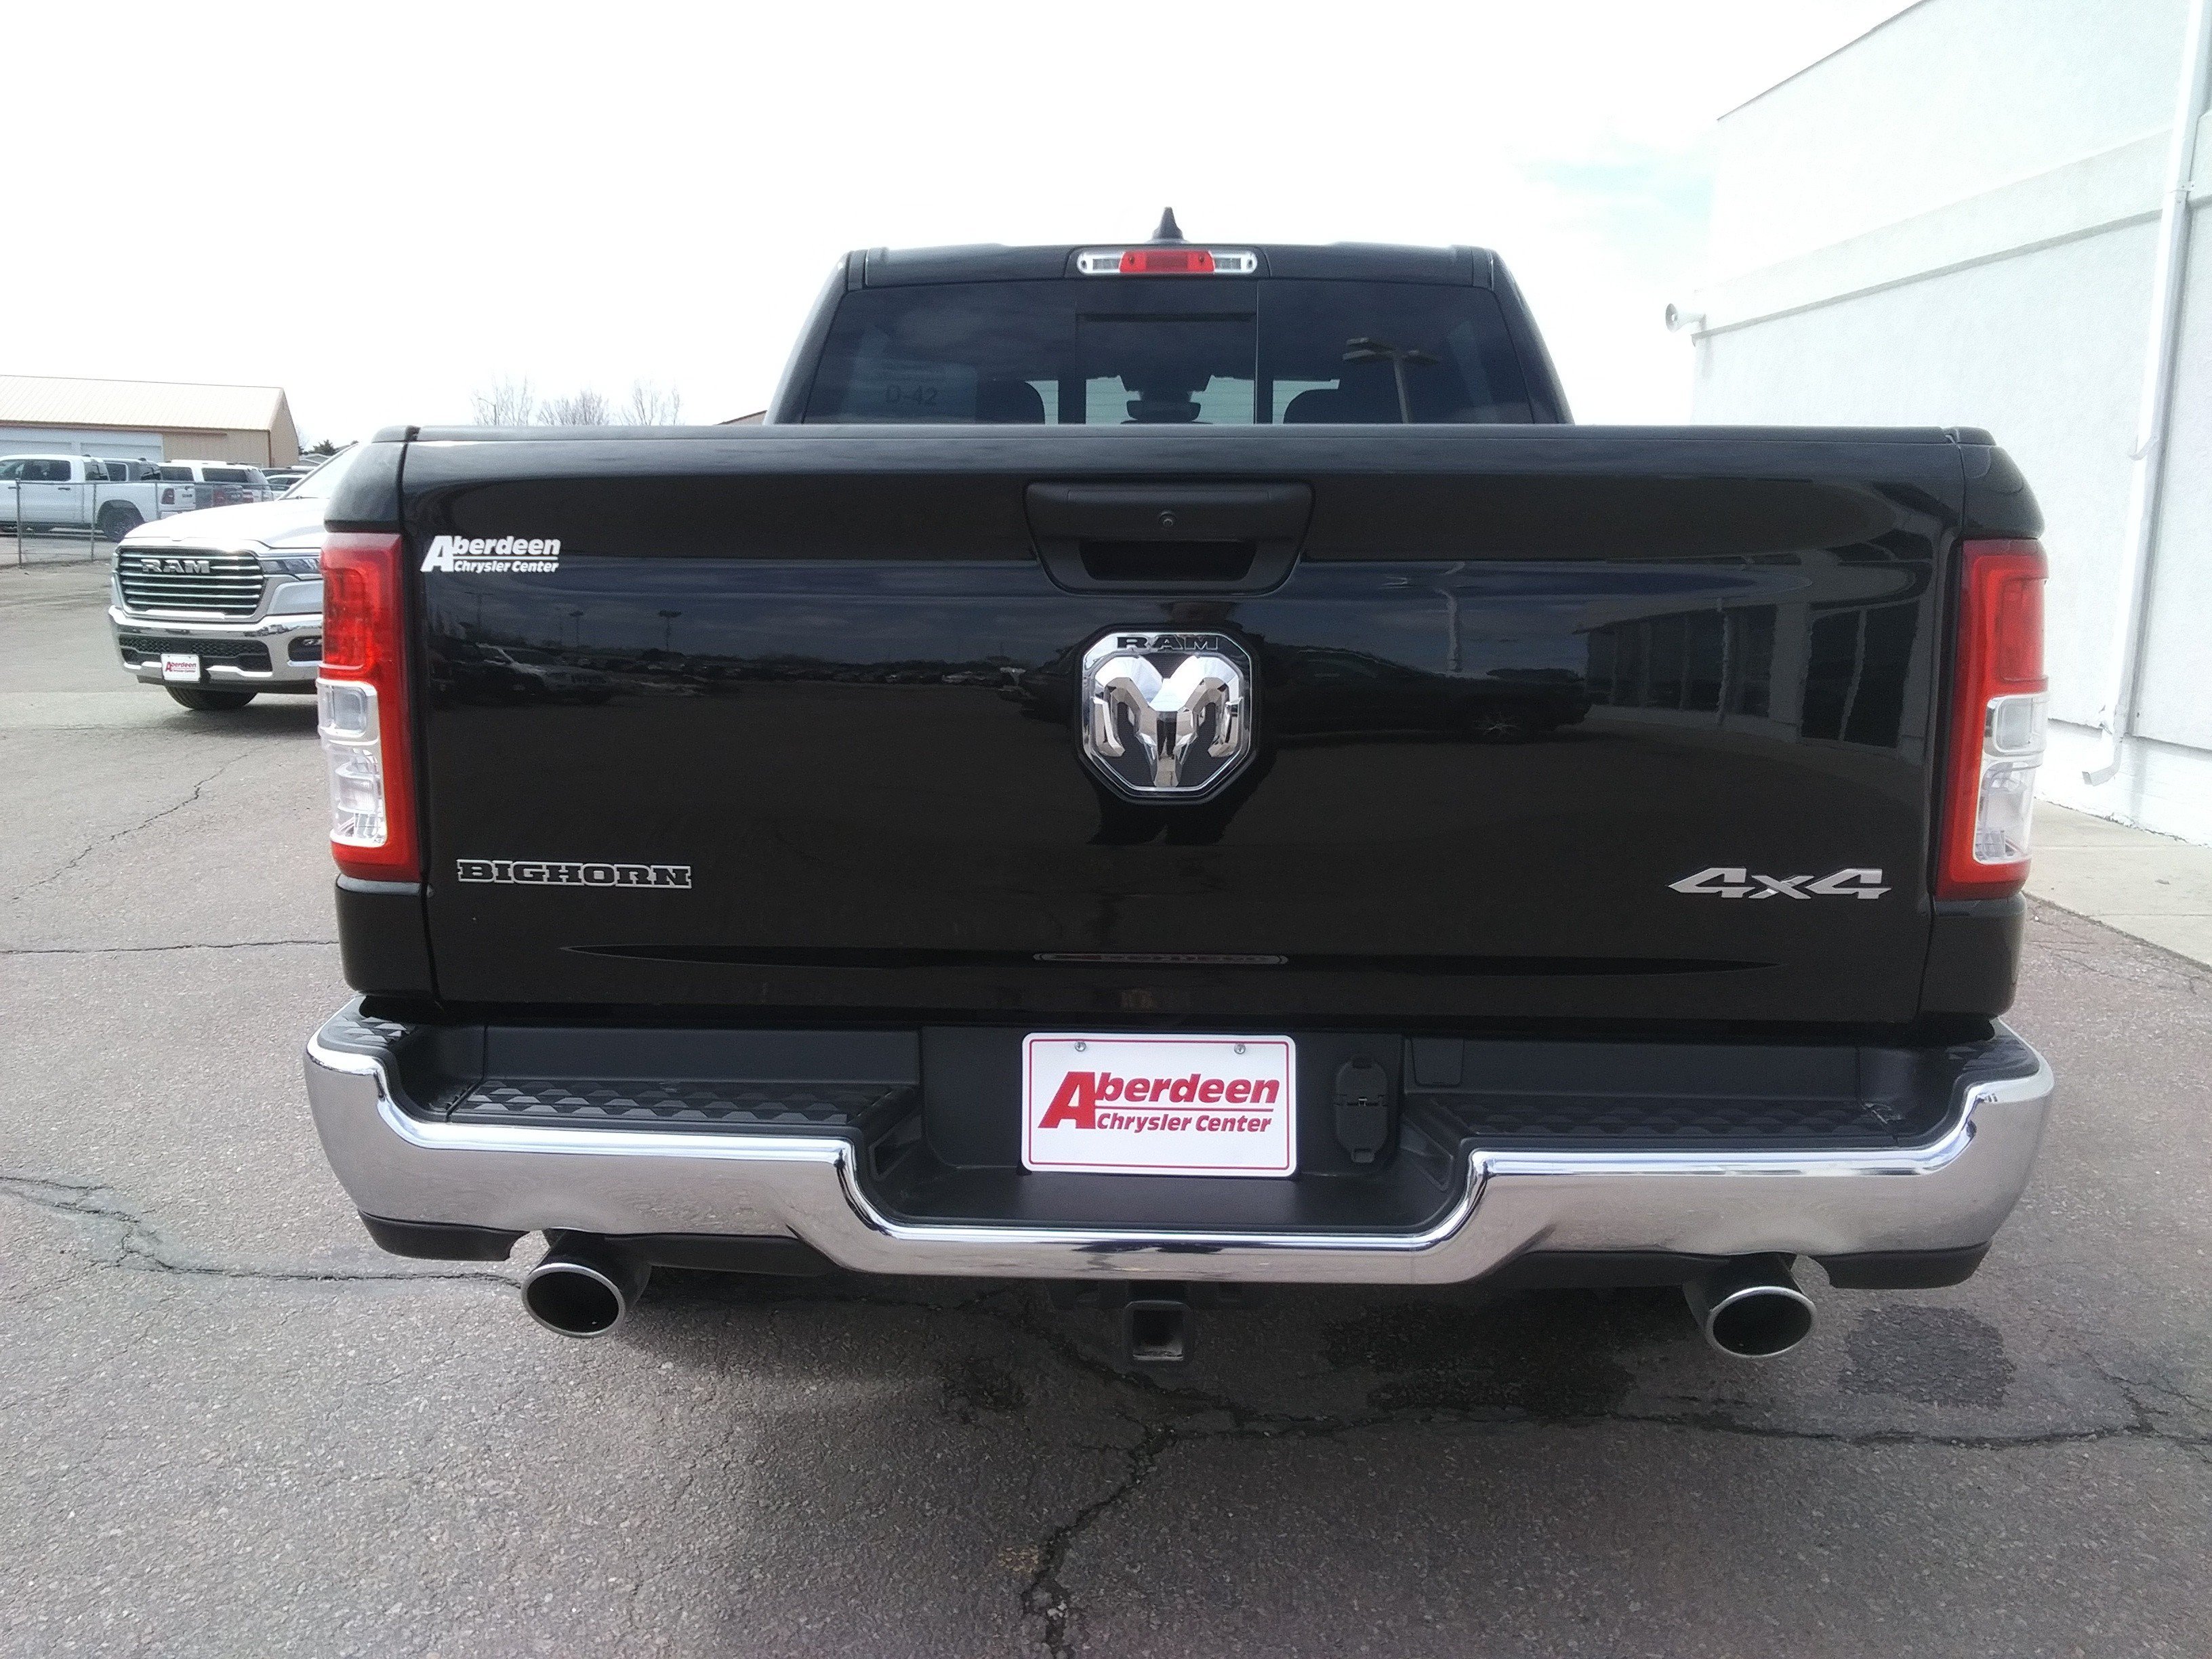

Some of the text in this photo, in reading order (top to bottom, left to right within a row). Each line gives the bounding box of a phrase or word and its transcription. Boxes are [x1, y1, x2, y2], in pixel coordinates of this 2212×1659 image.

[421, 535, 561, 572] Aberdeen
[140, 558, 209, 574] RAM
[454, 560, 559, 573] Chrysler Center
[1117, 634, 1218, 651] RAM
[457, 859, 692, 888] BIGHORN
[1038, 1071, 1280, 1129] Aberdeen
[1097, 1113, 1271, 1133] Chrysler Center
